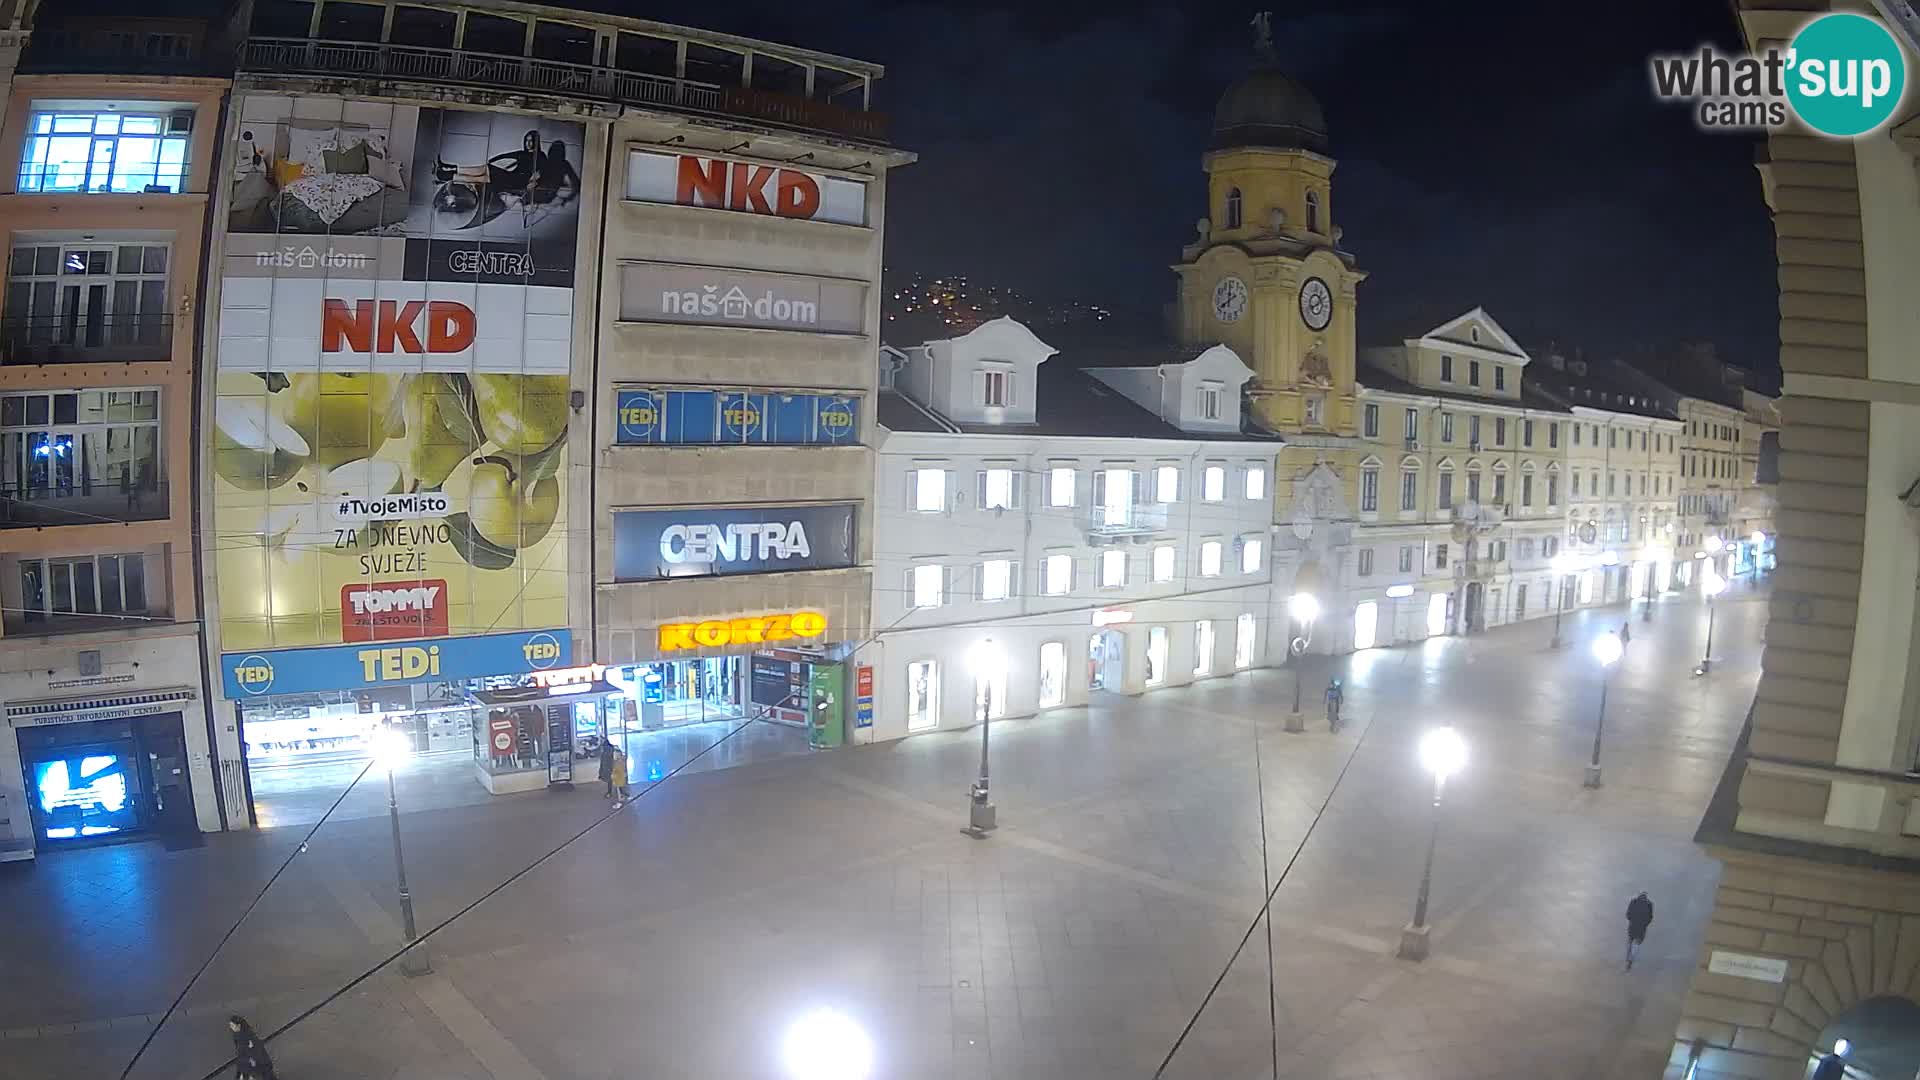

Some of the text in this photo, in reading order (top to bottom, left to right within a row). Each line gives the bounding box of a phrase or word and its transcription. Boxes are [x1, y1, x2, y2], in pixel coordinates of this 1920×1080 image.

[675, 155, 821, 219] NKD
[256, 245, 367, 270] naš dom
[448, 250, 536, 277] CENTRA
[661, 284, 817, 323] naš dom
[321, 298, 477, 354] NKD
[620, 408, 658, 426] TEDi
[723, 409, 760, 426] TEDi
[820, 411, 853, 427] TEDi
[339, 497, 447, 516] #TvojeMisto
[334, 523, 451, 549] ZA DNEVNO
[660, 521, 811, 564] CENTRA
[360, 547, 428, 575] SVJEŽE
[349, 586, 440, 615] TOMMY
[659, 612, 827, 651] KORZO
[358, 645, 441, 682] TEDi
[522, 642, 560, 661] TEDi
[235, 665, 274, 685] TEDi
